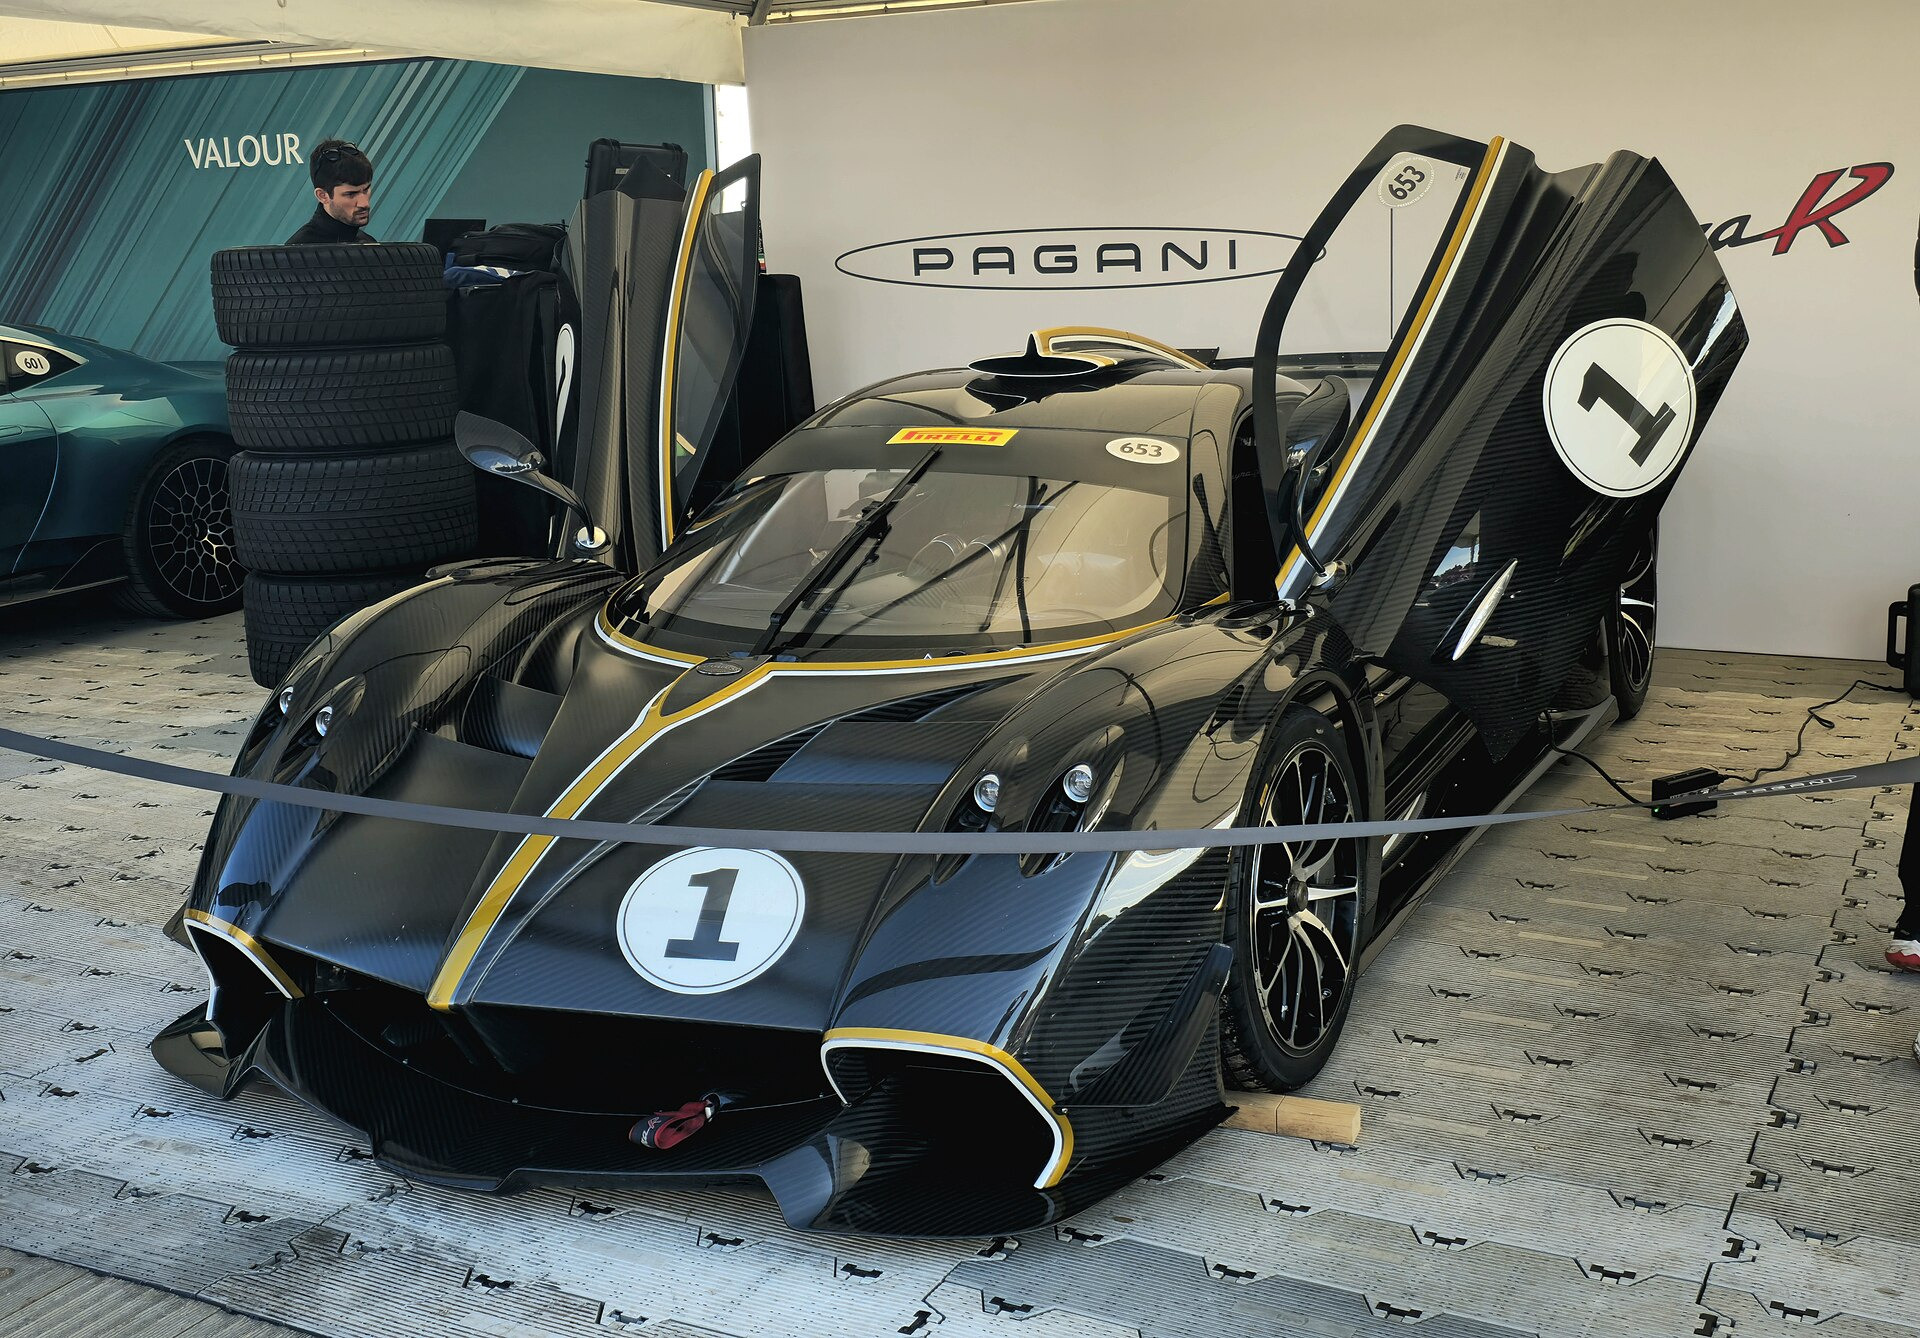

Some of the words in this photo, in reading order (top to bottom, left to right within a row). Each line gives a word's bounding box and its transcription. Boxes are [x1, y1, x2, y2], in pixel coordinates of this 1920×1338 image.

[184, 133, 304, 169] VALOUR
[1388, 165, 1425, 200] 653
[913, 239, 1236, 276] PAGANI
[24, 357, 44, 370] 601
[1577, 361, 1677, 467] 1
[900, 430, 1003, 442] PIRELLI
[1119, 442, 1163, 458] 653
[664, 867, 740, 962] 1
